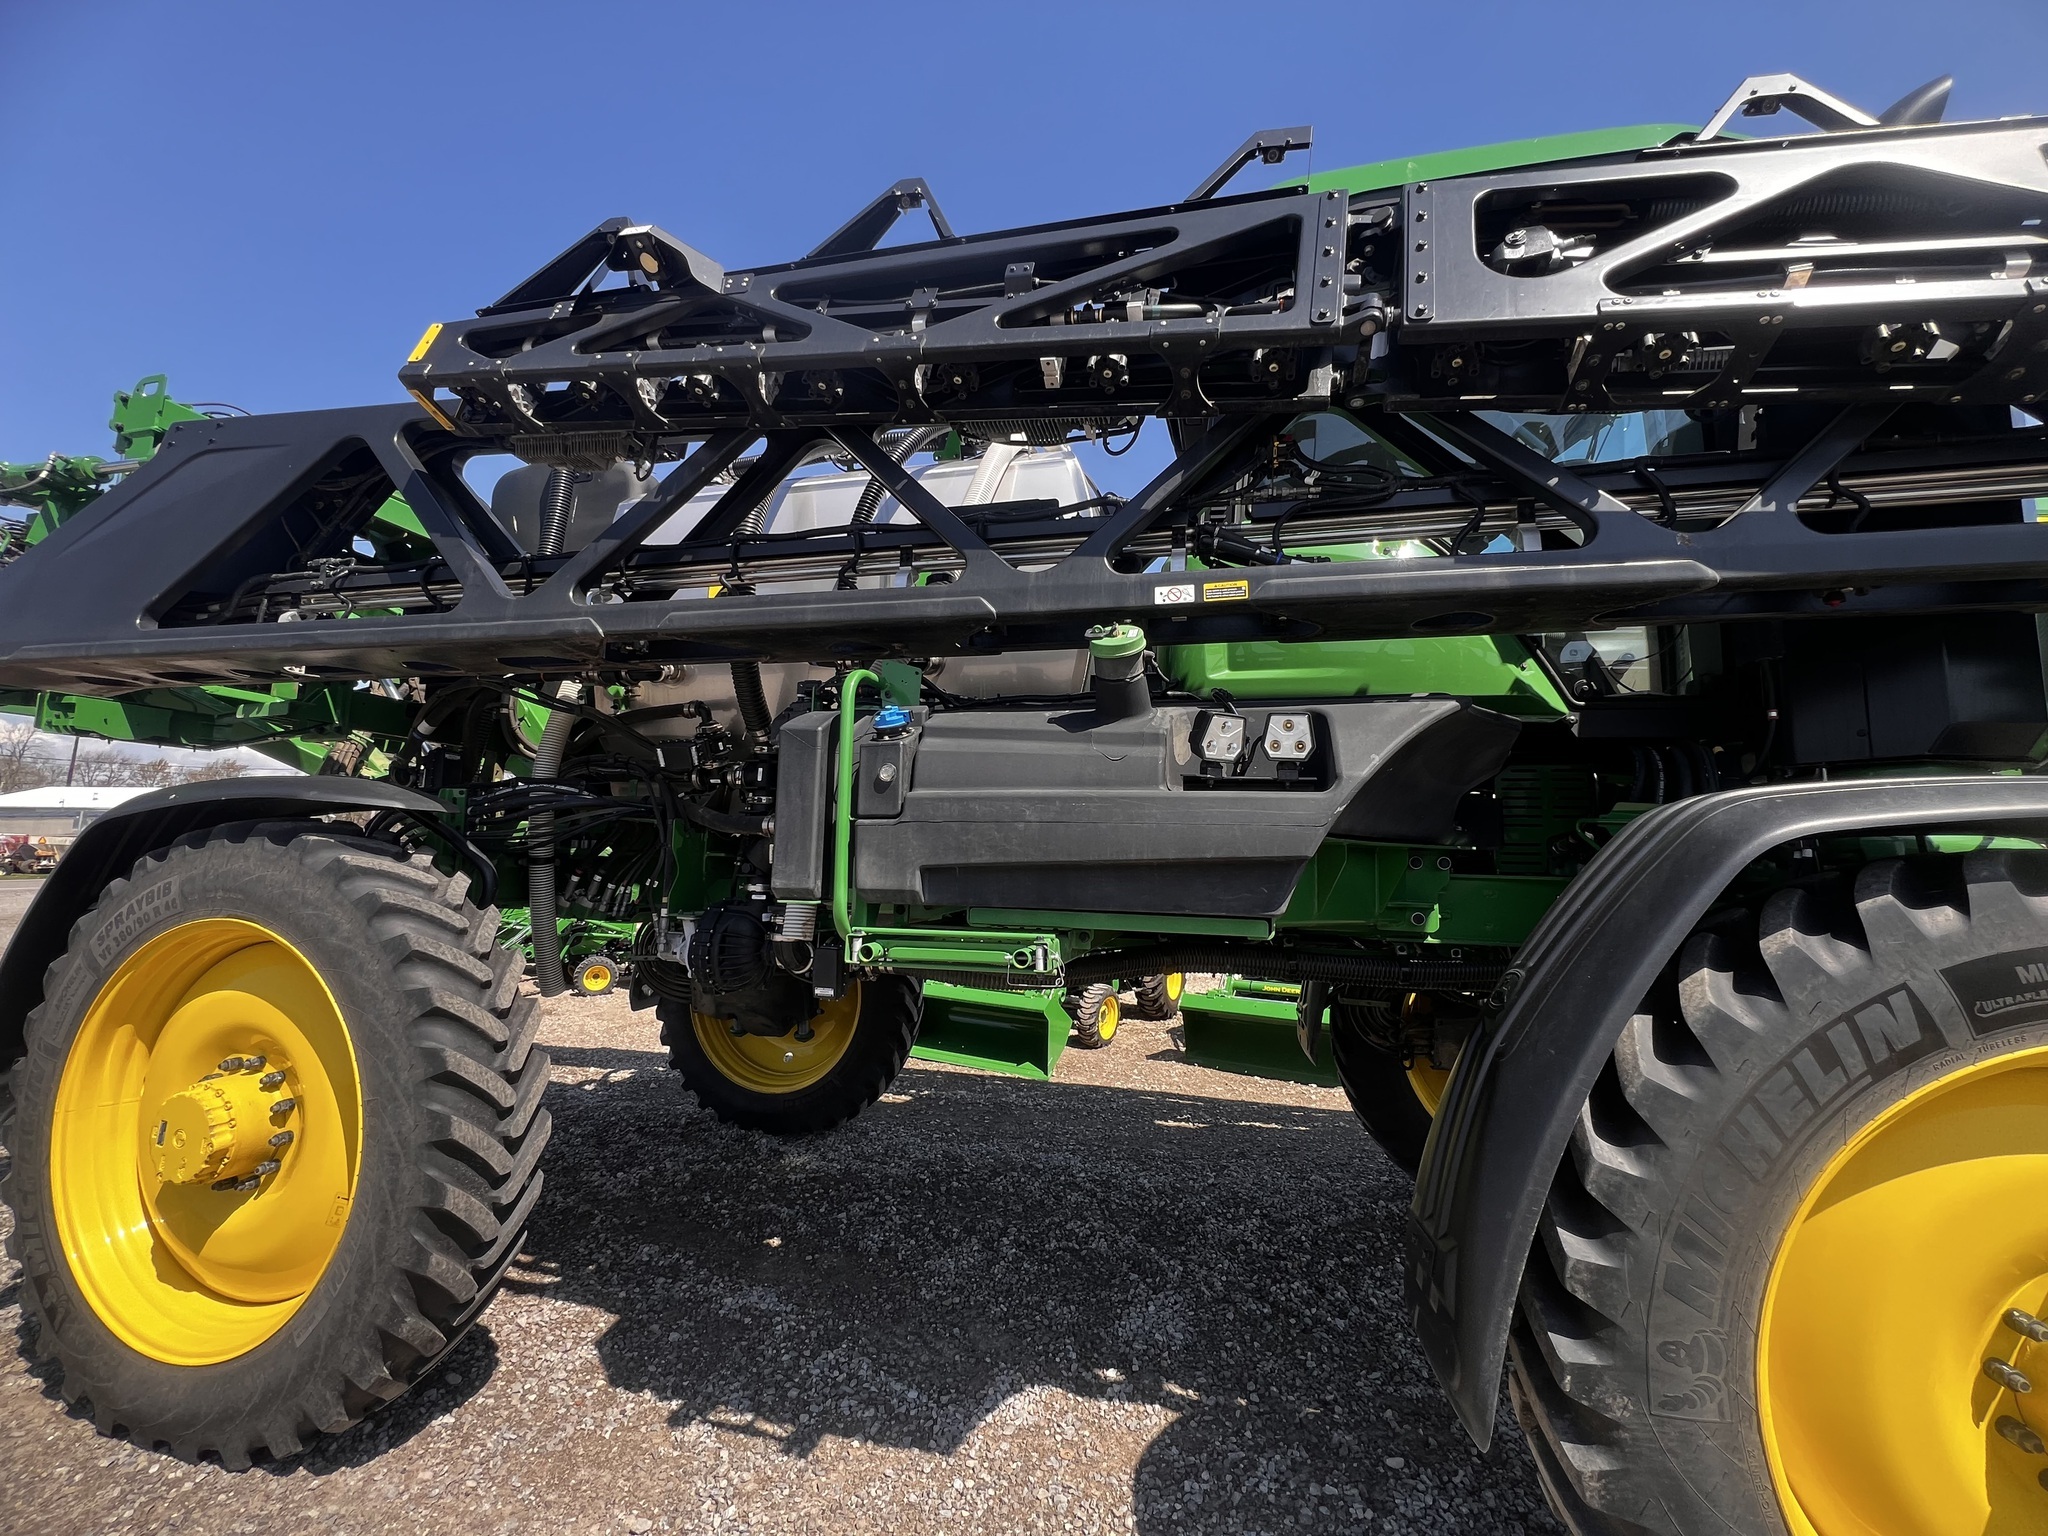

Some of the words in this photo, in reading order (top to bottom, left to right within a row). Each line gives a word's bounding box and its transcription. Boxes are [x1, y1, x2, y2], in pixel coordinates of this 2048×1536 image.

[96, 880, 173, 947] SPRAYBIB
[98, 944, 112, 961] VF
[152, 905, 162, 919] R
[1262, 985, 1281, 993] JOHN
[1931, 1053, 1967, 1072] RADIAL
[1976, 1035, 2027, 1054] TUBELESS
[1662, 989, 1922, 1320] MICHELIN
